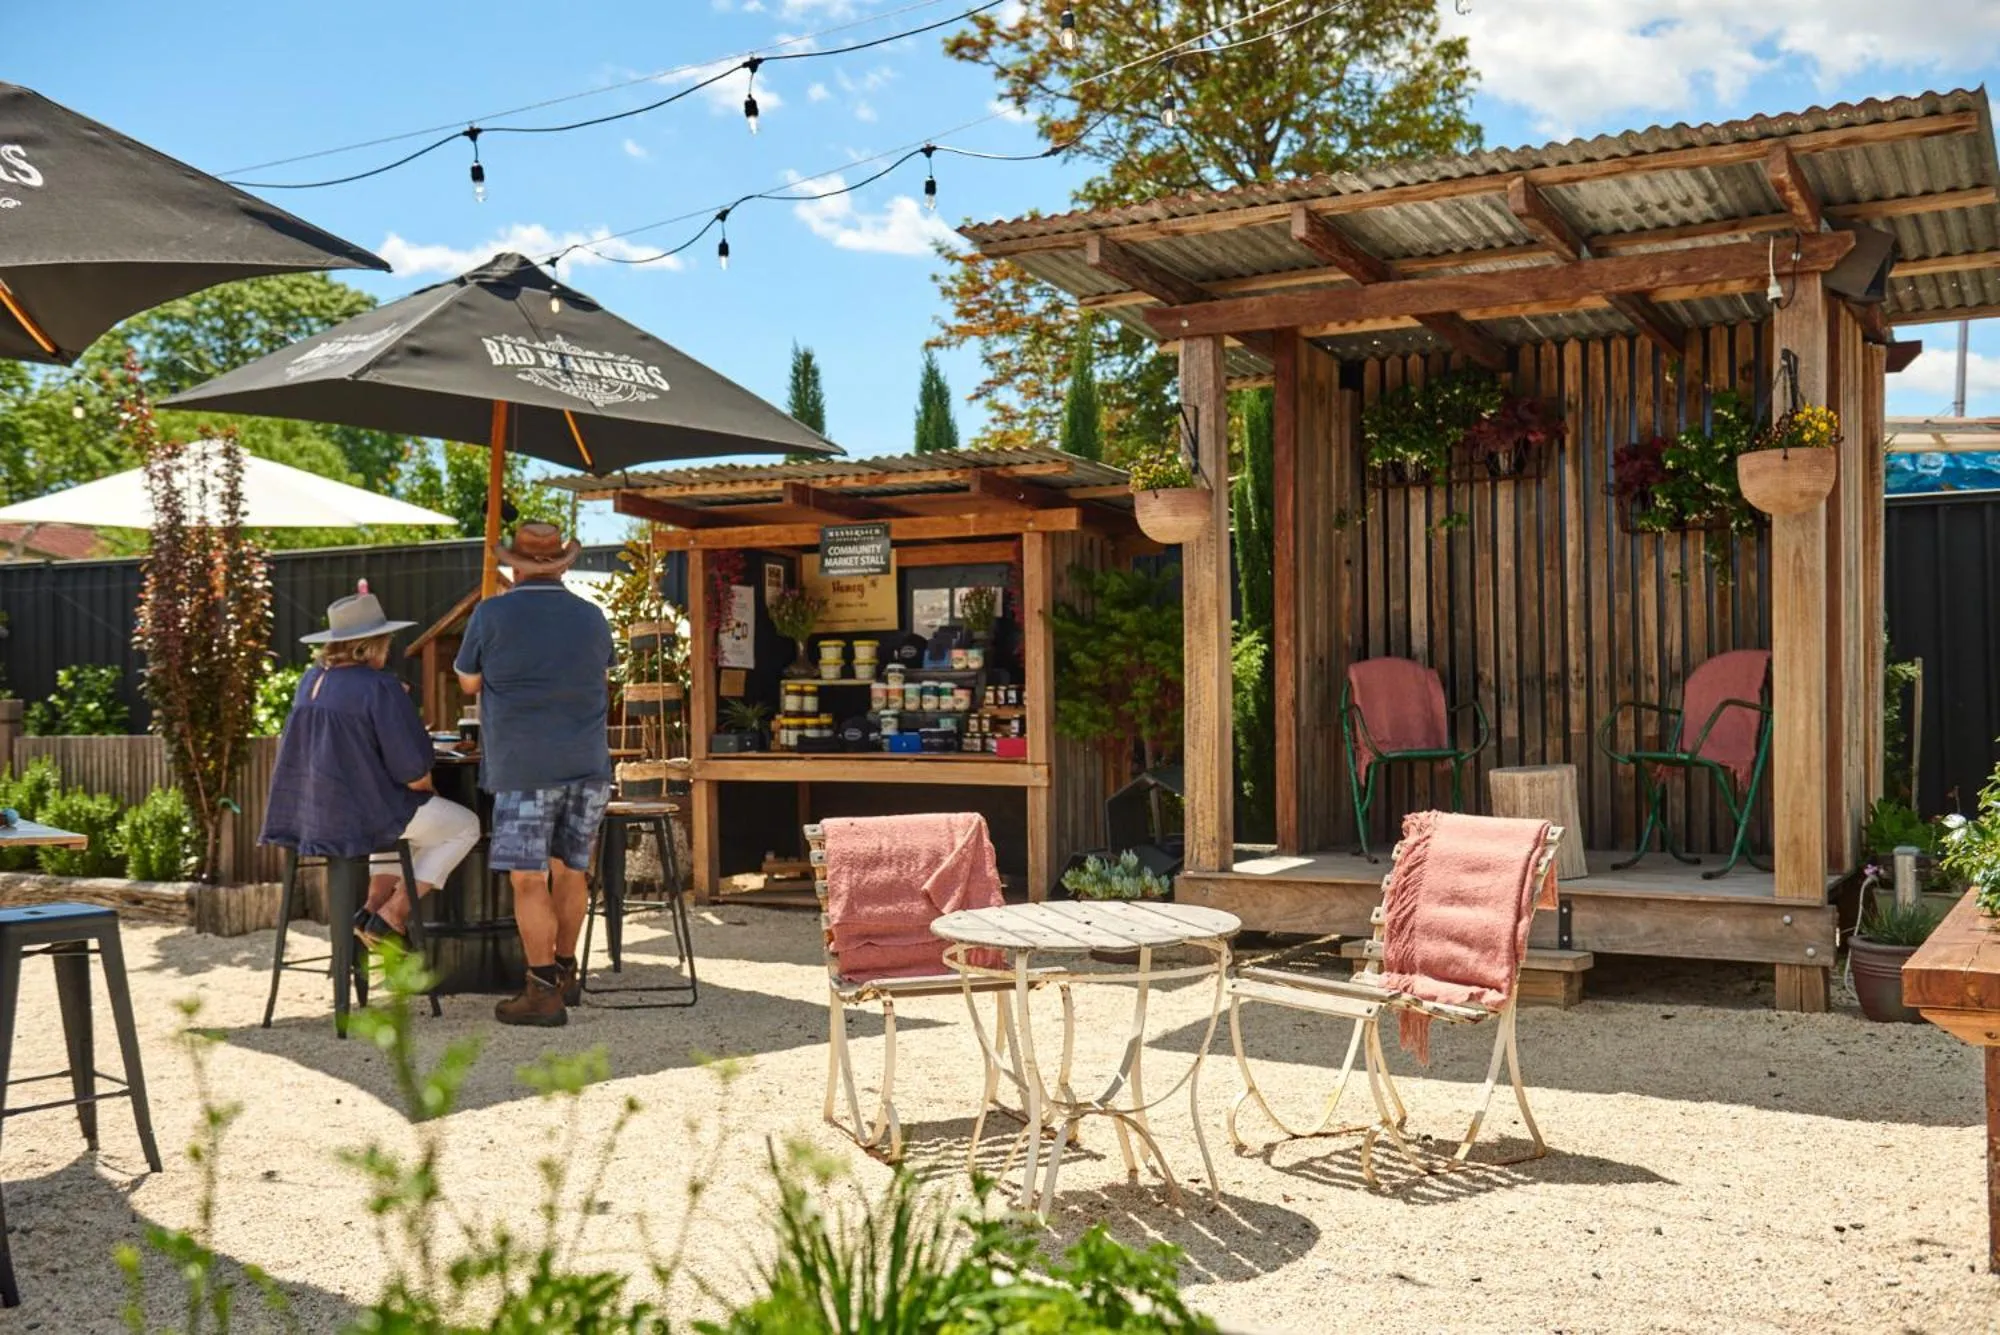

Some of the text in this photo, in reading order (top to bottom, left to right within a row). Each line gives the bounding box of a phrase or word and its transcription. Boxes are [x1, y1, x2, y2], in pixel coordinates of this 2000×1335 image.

[481, 337, 537, 366] BAD
[539, 350, 671, 392] MANNERS
[827, 544, 882, 556] COMMUNITY
[824, 555, 886, 567] MARKET STALL
